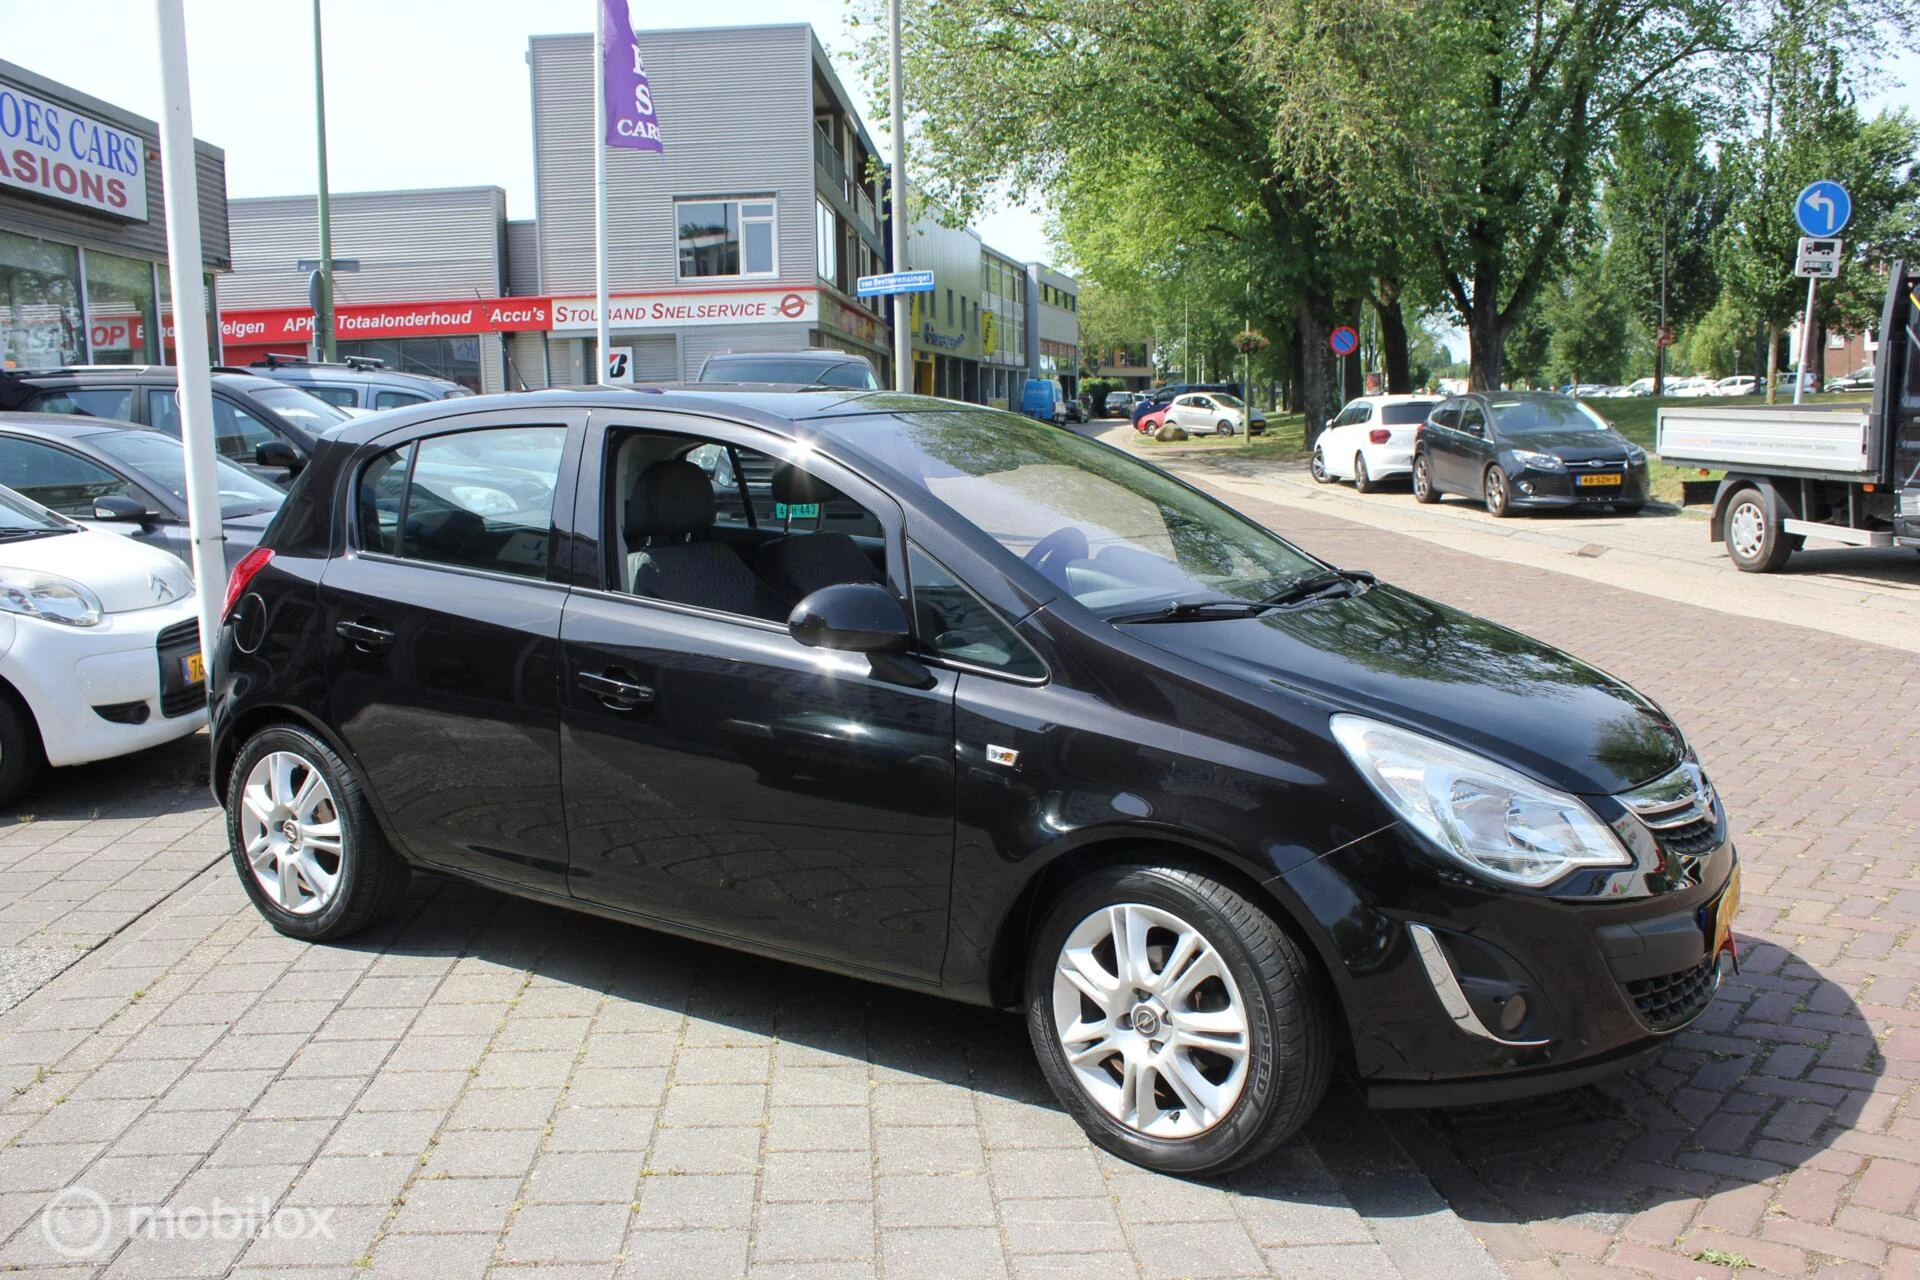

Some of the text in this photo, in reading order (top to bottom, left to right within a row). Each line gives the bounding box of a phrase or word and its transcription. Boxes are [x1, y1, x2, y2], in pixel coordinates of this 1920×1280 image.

[69, 118, 138, 177] CARS
[283, 316, 315, 332] APK
[338, 310, 472, 330] Totaalonderhoud
[490, 307, 545, 323] Accu's
[651, 303, 766, 320] SNELSERVICE
